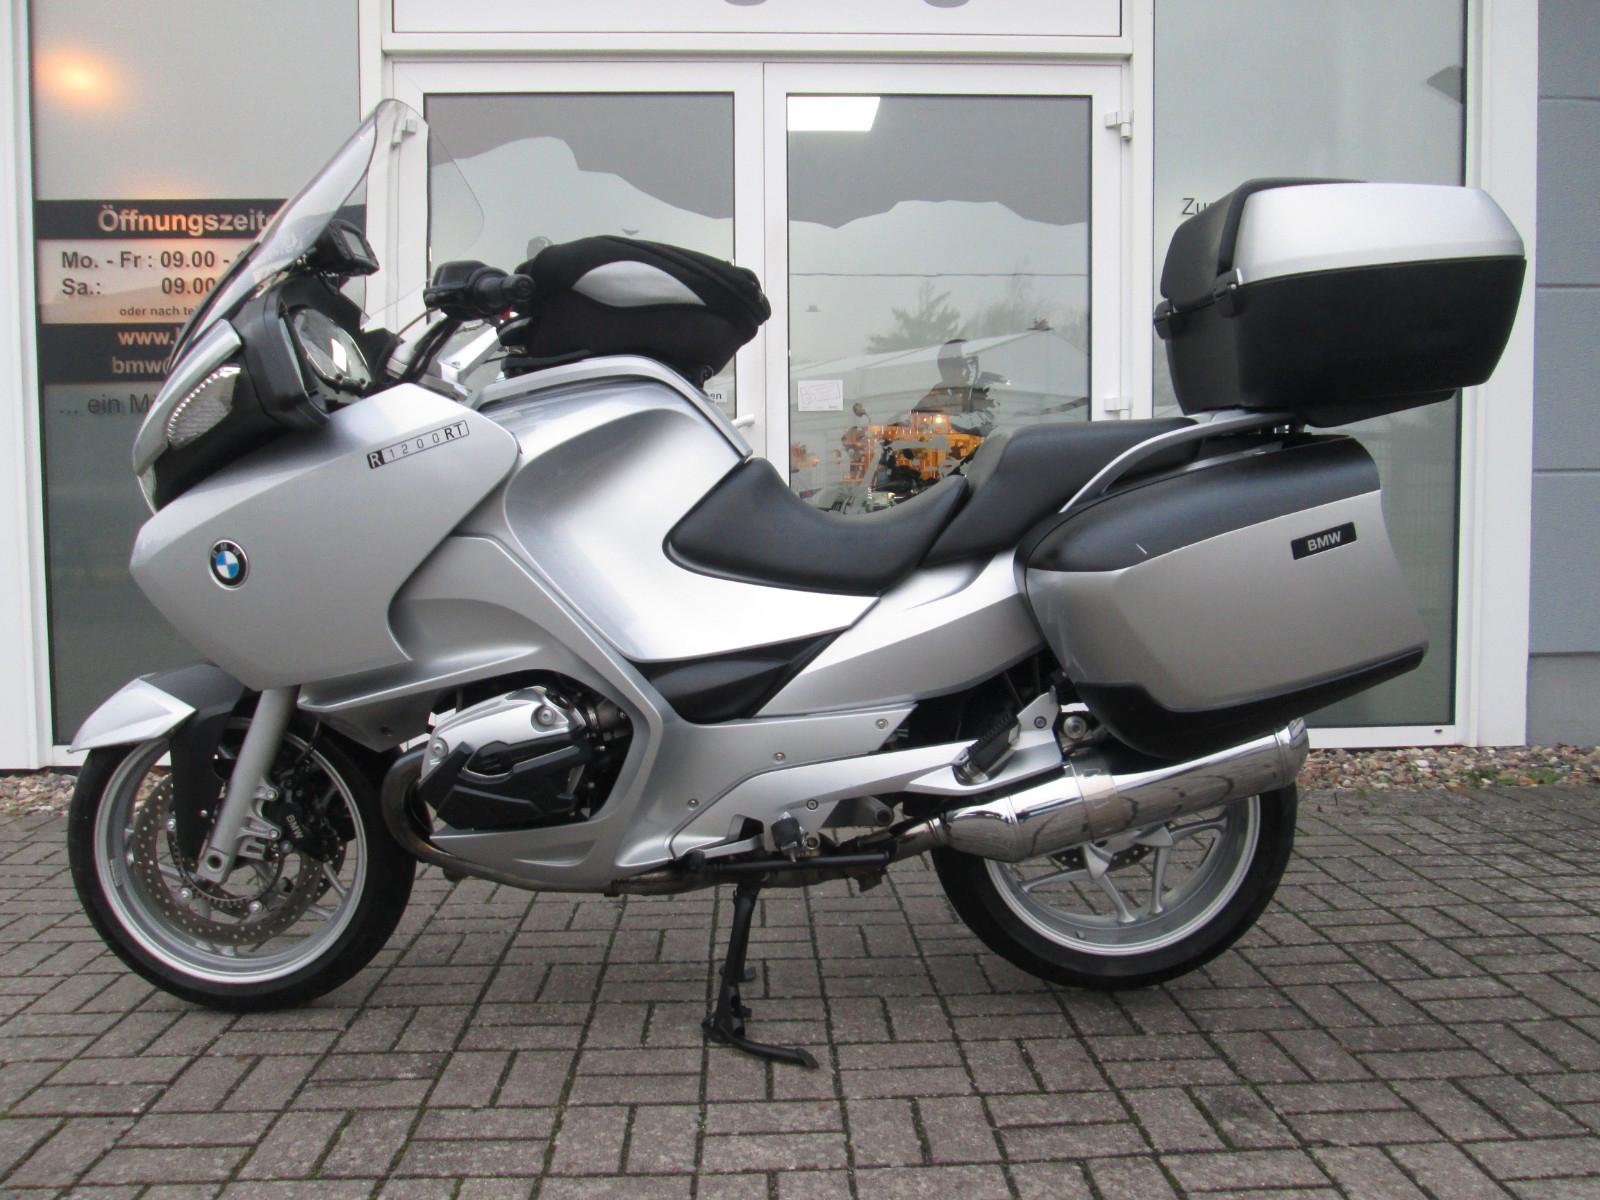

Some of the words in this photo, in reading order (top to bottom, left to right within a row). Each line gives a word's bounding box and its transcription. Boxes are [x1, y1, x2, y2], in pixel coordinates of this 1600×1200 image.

[62, 251, 99, 268] Mo.
[160, 251, 215, 268] 09.00
[161, 277, 216, 295] 09.00
[119, 307, 147, 317] oder
[150, 306, 180, 316] nach
[183, 306, 198, 316] te
[87, 394, 120, 415] ein
[1307, 531, 1341, 552] BMW
[286, 814, 304, 838] BMW
